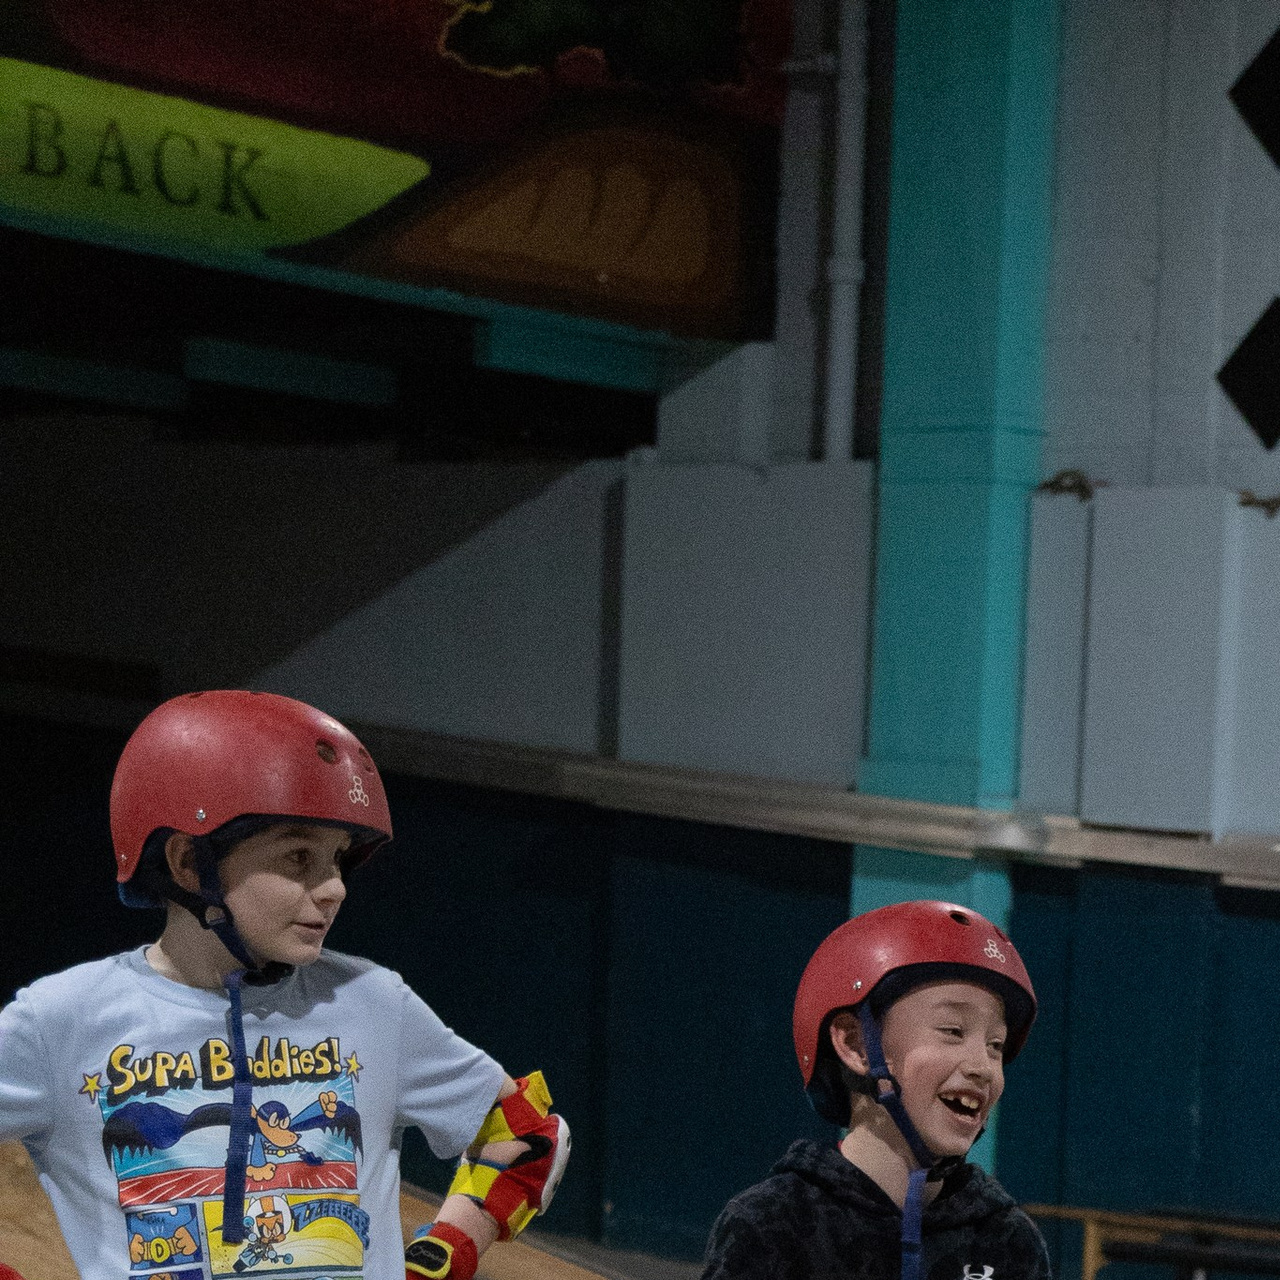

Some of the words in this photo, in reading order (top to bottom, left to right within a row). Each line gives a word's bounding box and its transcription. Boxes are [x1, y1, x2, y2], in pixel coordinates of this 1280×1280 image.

[20, 100, 272, 222] BACK
[204, 1036, 342, 1084] Bddies!
[155, 1243, 165, 1258] D
